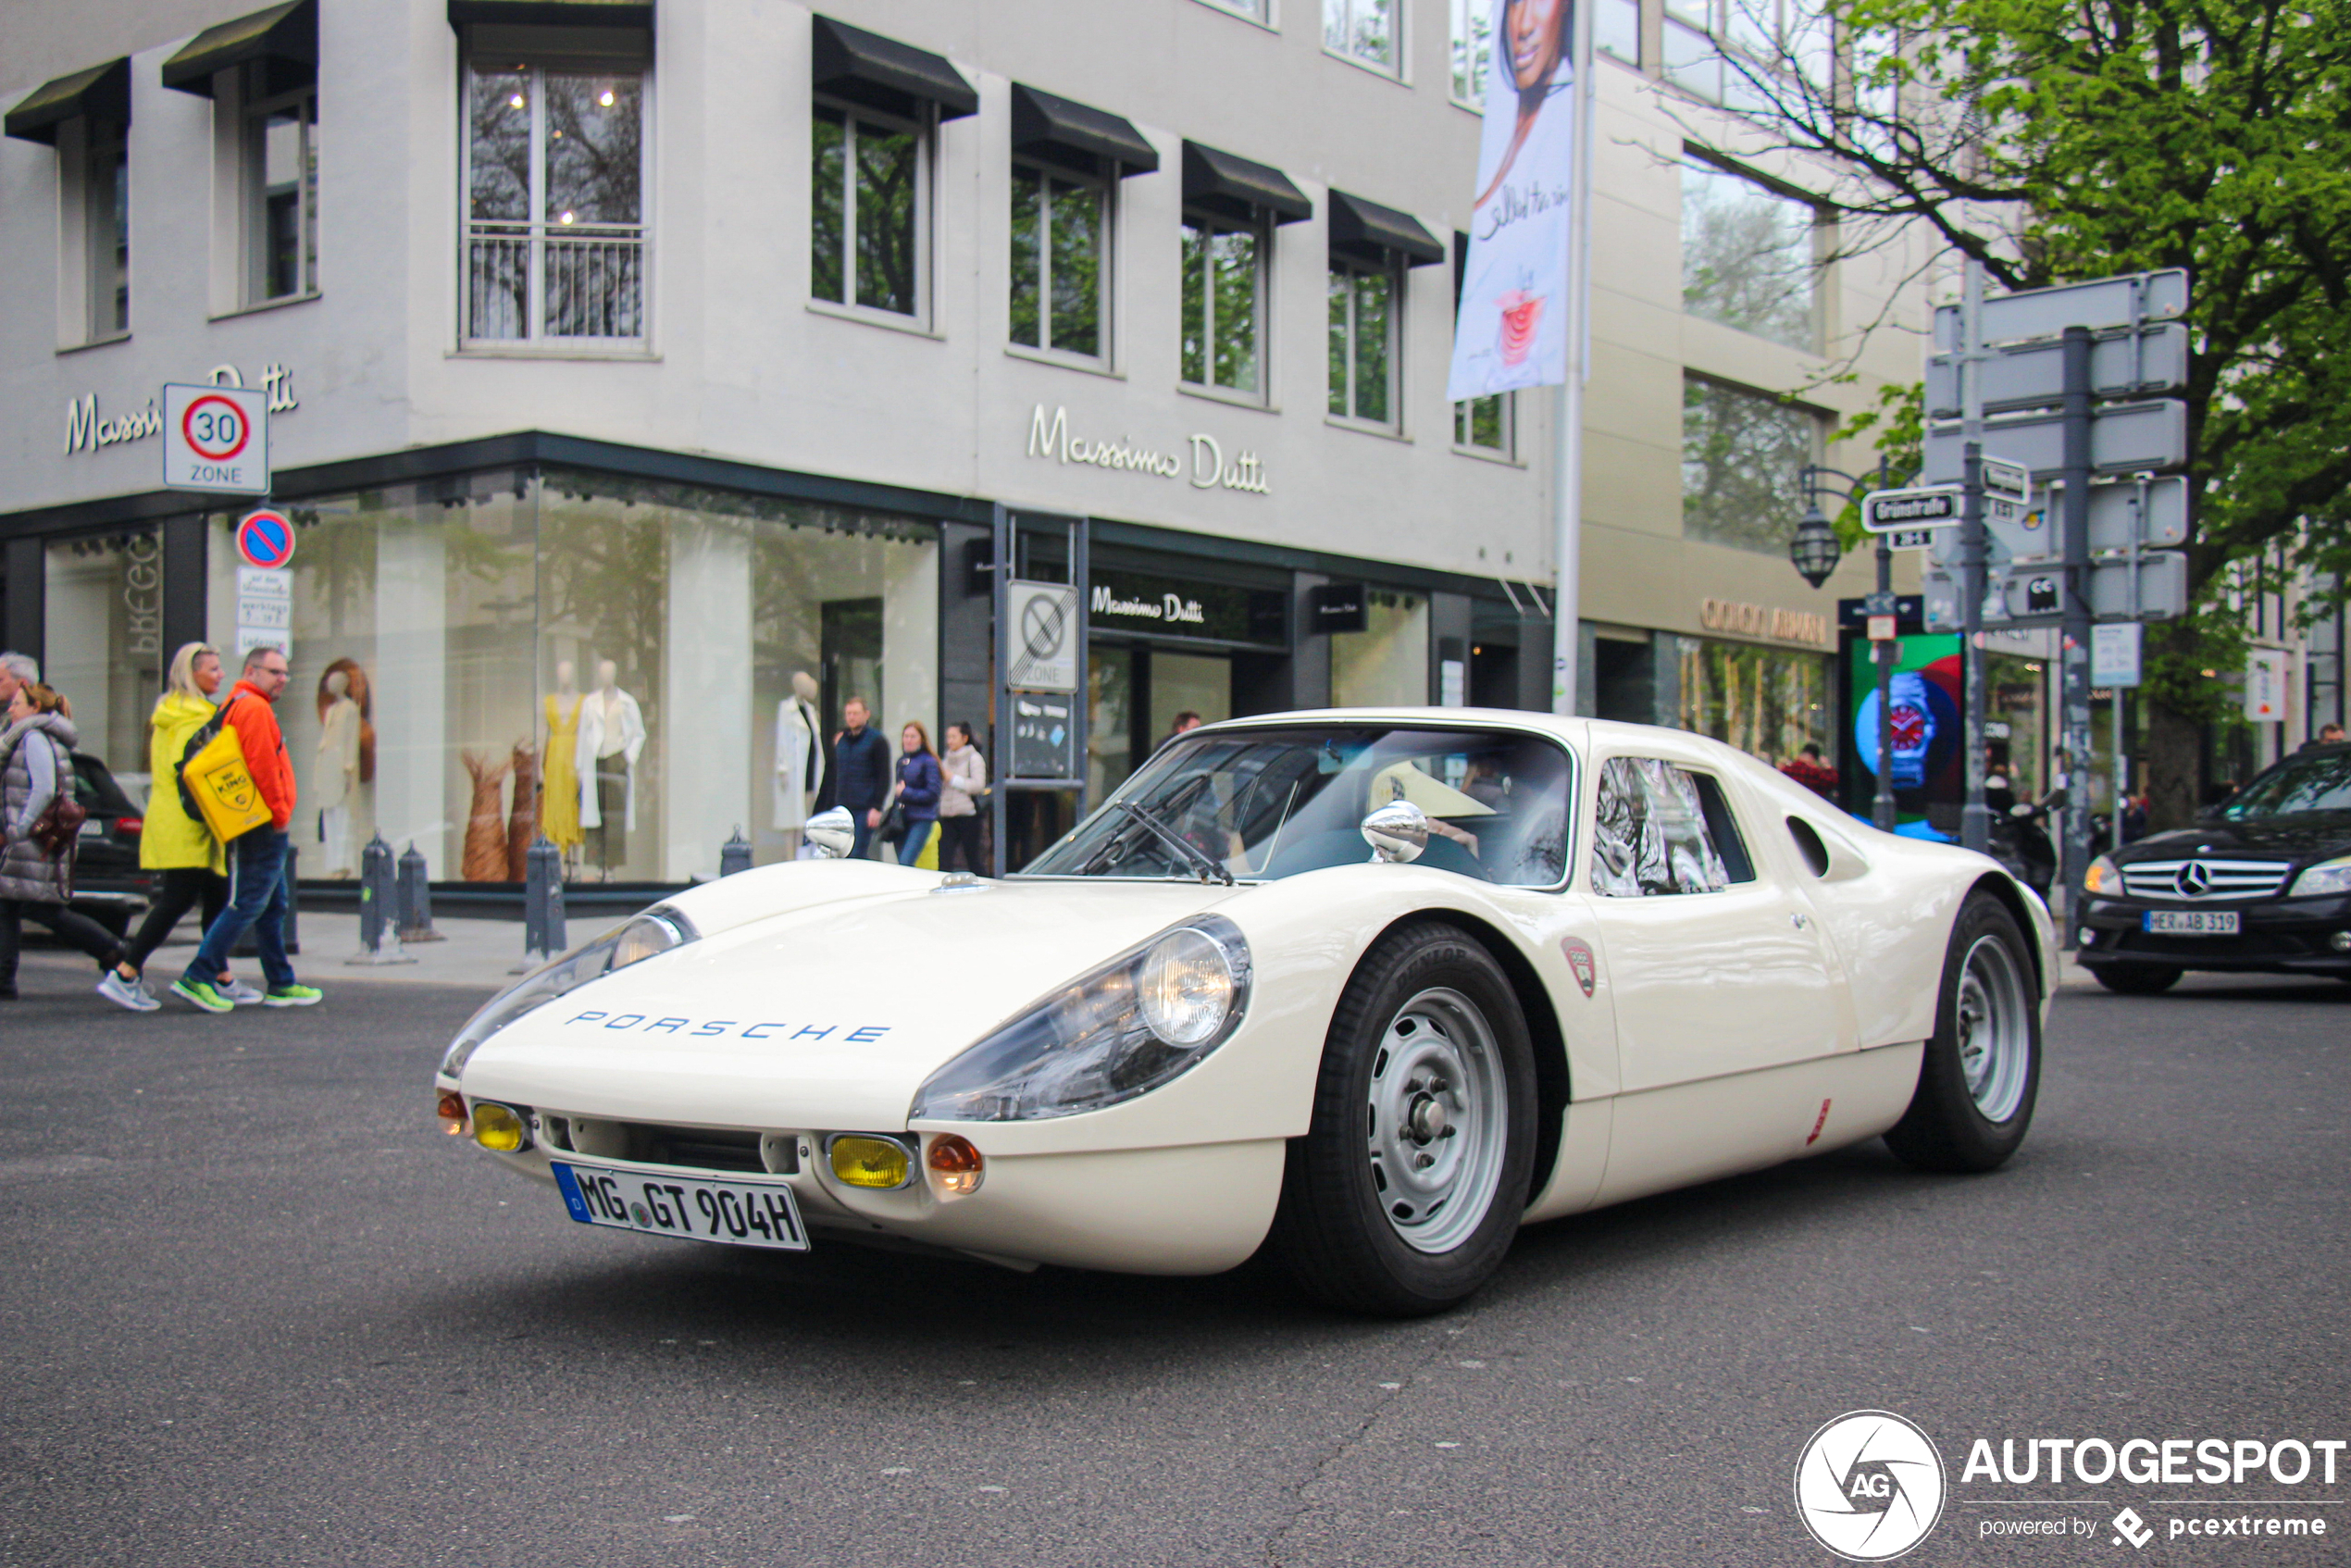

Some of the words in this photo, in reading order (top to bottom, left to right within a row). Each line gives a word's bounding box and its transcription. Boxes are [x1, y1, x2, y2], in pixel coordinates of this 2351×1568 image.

[65, 391, 162, 455] Massi
[196, 412, 236, 443] 30
[1027, 403, 1181, 479] Massimo
[1188, 433, 1273, 495] Dutti
[191, 465, 243, 484] ZONE
[1091, 585, 1162, 618] Massimo
[1163, 592, 1205, 624] Dutti
[1026, 665, 1061, 683] ZONE
[2150, 913, 2176, 930] HER
[2184, 913, 2205, 930] AB
[2208, 914, 2235, 931] 319
[565, 1010, 892, 1043] PORSCHE
[575, 1172, 630, 1221] MG
[642, 1181, 692, 1232] GT
[695, 1187, 800, 1242] 904H
